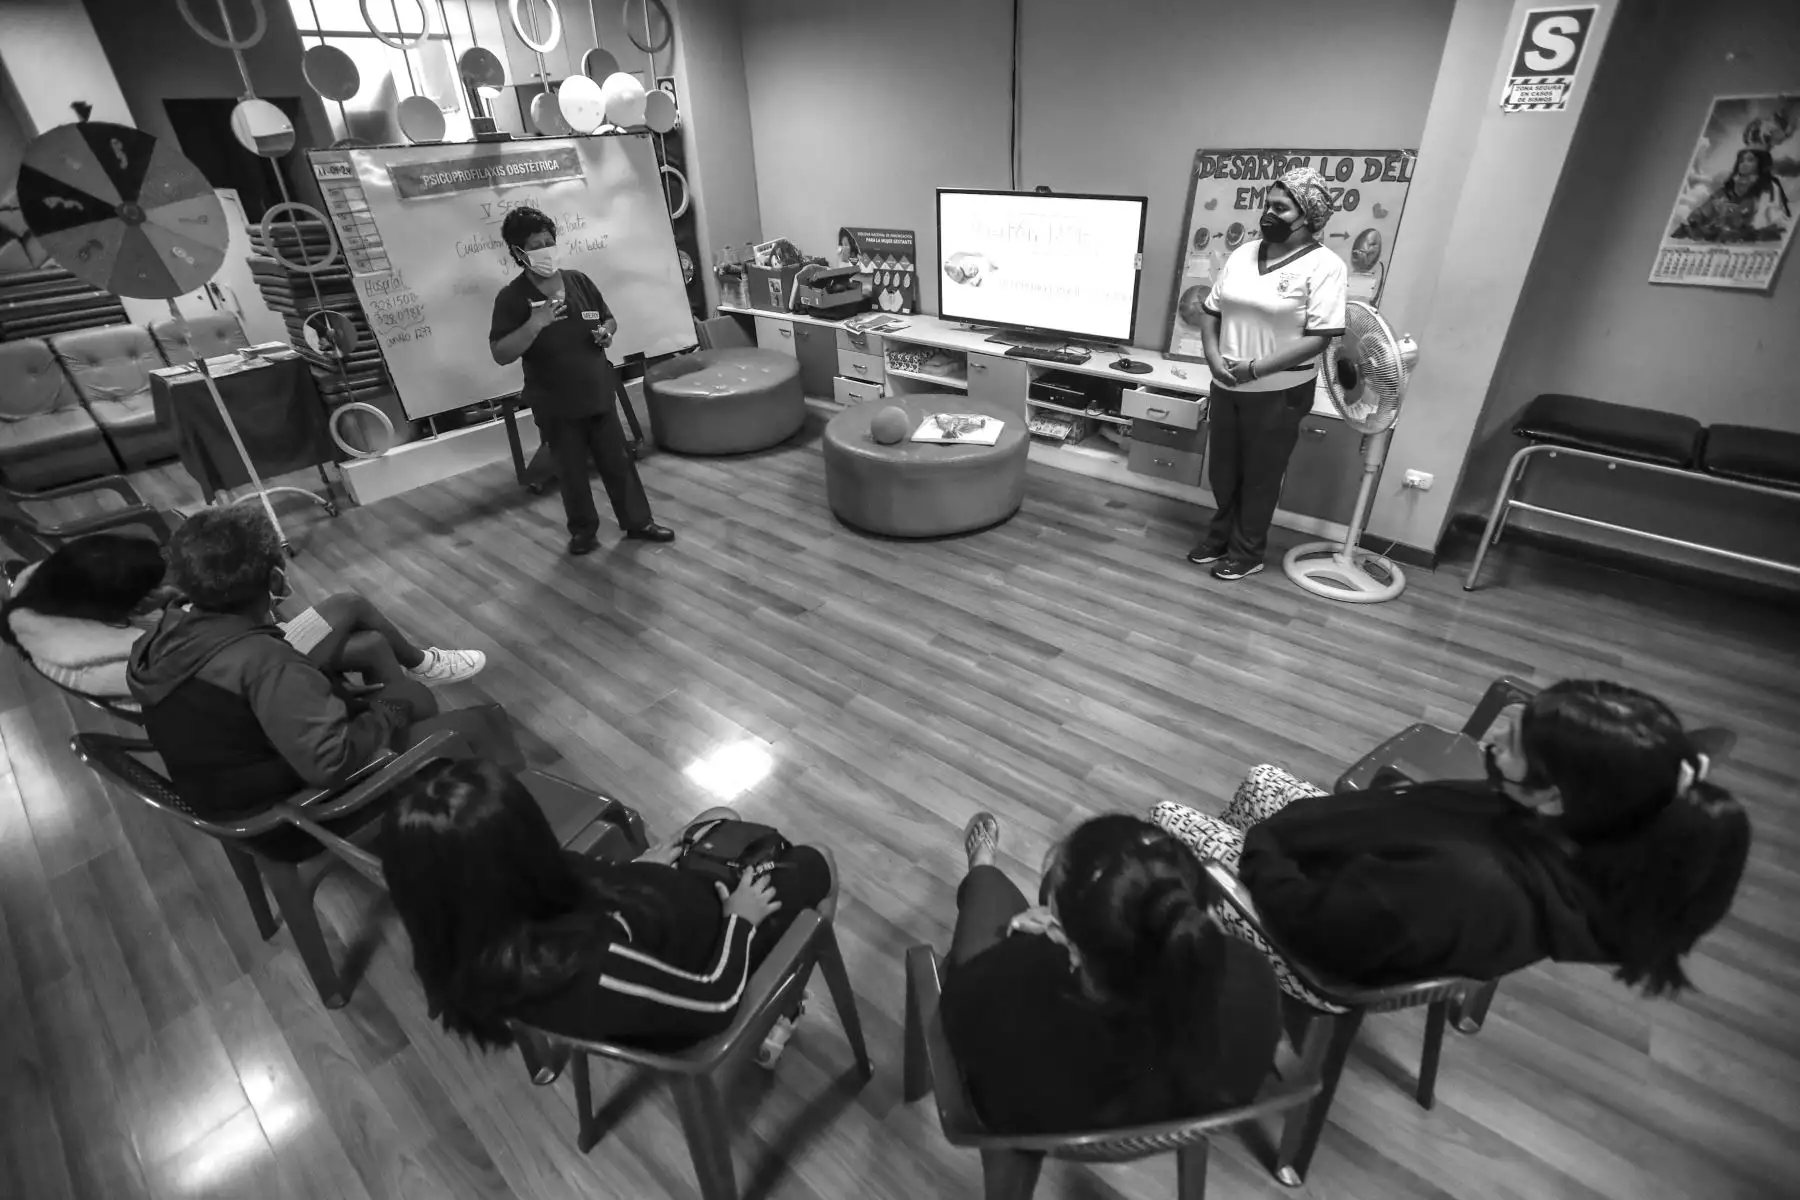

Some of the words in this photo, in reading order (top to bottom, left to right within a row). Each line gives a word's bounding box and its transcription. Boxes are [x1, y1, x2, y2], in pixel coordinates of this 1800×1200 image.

[1524, 16, 1580, 71] S
[423, 165, 505, 187] PSICOPROFILAXIS
[1361, 156, 1412, 183] DEL
[1234, 186, 1361, 212] EMZO
